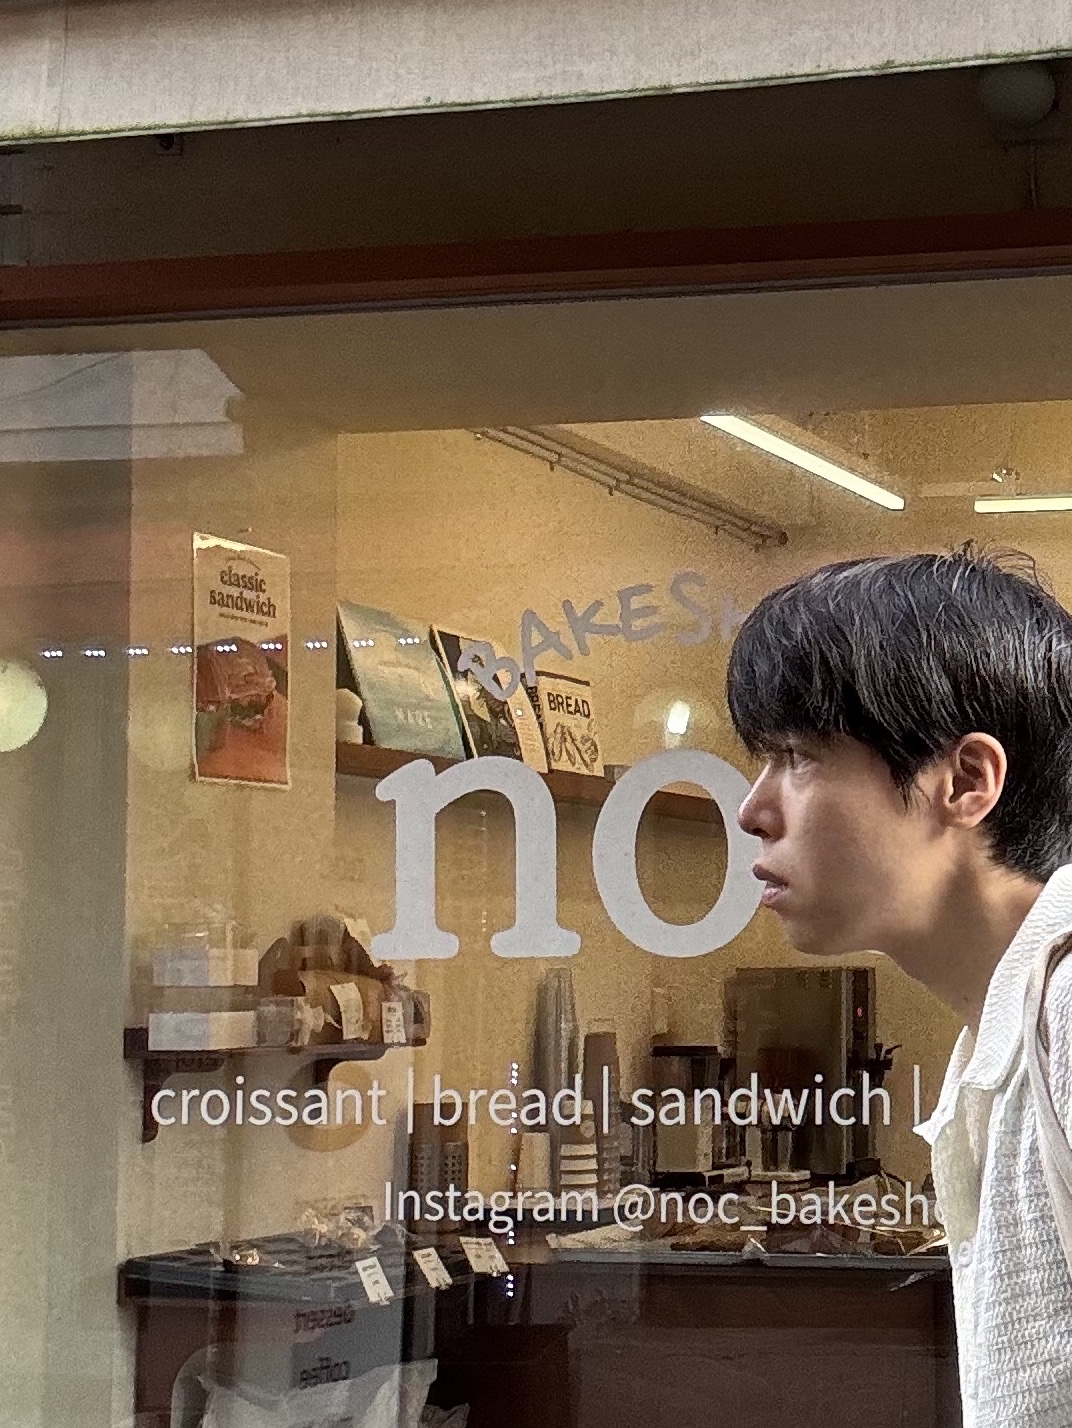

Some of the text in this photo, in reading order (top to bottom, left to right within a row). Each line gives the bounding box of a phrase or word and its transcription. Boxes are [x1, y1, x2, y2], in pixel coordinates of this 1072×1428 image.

[220, 565, 267, 593] classic
[209, 589, 277, 619] sandwich
[547, 691, 591, 719] BREAD
[371, 749, 764, 959] no
[151, 1075, 387, 1126] croissant
[433, 1074, 582, 1126] bread
[630, 1072, 891, 1126] sandwich
[385, 1182, 599, 1233] Instagram
